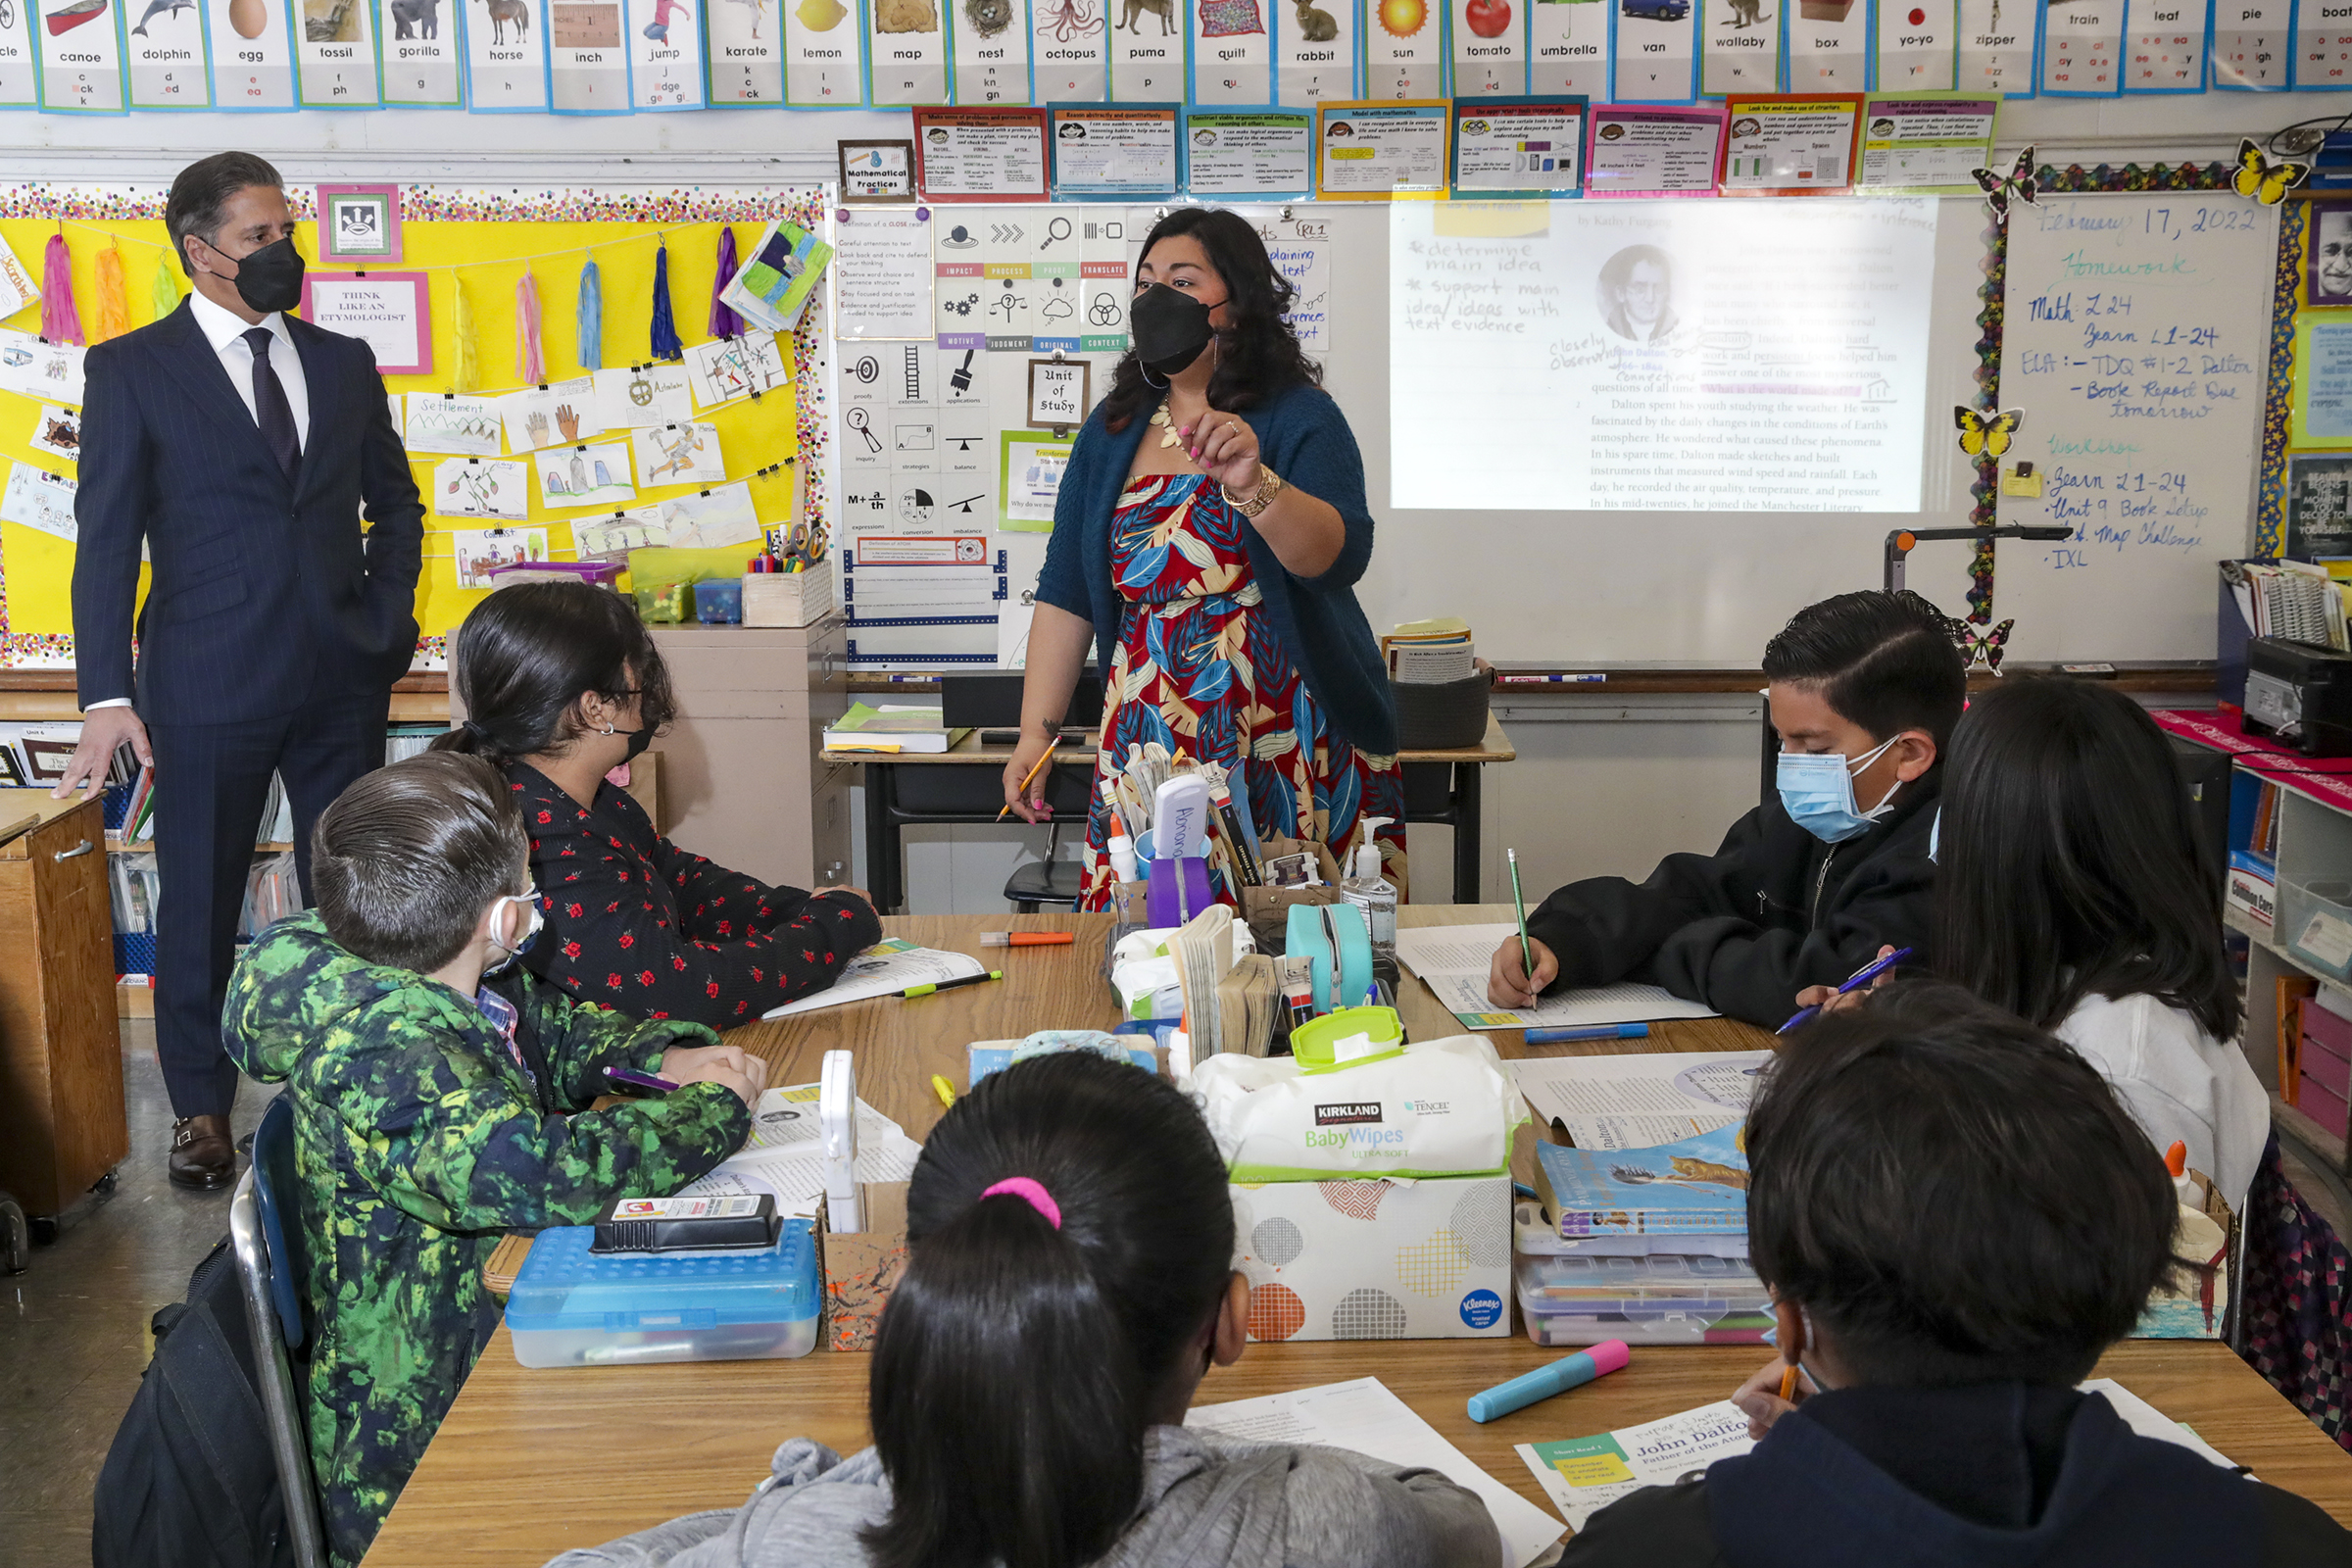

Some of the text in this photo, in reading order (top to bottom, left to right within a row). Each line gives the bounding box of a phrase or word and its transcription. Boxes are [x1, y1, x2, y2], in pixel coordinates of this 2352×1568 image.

[2070, 14, 2099, 24] train
[2154, 10, 2180, 22] leaf
[2242, 9, 2263, 21] pie
[1716, 36, 1766, 49] wallaby
[1815, 37, 1839, 48] box
[1899, 34, 1934, 47] yo-yo
[1976, 33, 2016, 46] zipper
[319, 47, 353, 58] fossil
[399, 46, 440, 60] gorilla
[725, 46, 767, 57] karate
[804, 47, 842, 59] lemon
[978, 48, 1004, 59] nest
[1393, 48, 1414, 58] sun
[1467, 45, 1511, 55] tomato
[1541, 44, 1597, 56] umbrella
[1643, 43, 1666, 52] van
[60, 53, 101, 64] canoe
[142, 49, 191, 61] dolphin
[238, 50, 264, 63] egg
[489, 50, 523, 60] horse
[575, 52, 602, 63] inch
[648, 48, 680, 62] jump
[894, 49, 922, 61] map
[1046, 47, 1097, 61] octopus
[1130, 49, 1165, 60] puma
[1218, 48, 1246, 61] quilt
[1297, 51, 1335, 61] rabbit
[1578, 217, 1591, 227] by
[1593, 216, 1625, 227] Kathy
[2037, 202, 2256, 247] February 17, 2022
[1427, 241, 1533, 258] determine
[1426, 257, 1543, 273] main idea
[2061, 249, 2197, 278] Homework
[1431, 278, 1560, 300] support main
[1518, 300, 1560, 318] with
[2107, 295, 2132, 316] 24
[1405, 317, 1526, 334] text evidence
[2092, 355, 2134, 376] TDQ
[2201, 354, 2253, 375] Dalton
[1045, 369, 1073, 381] Unit
[1053, 384, 1064, 396] of
[2086, 381, 2240, 407] Book Report Due
[420, 398, 483, 414] Settlement
[1040, 400, 1075, 414] Study
[1611, 399, 1645, 410] Dalton
[1648, 401, 1676, 412] spent
[1679, 400, 1694, 410] his
[1697, 400, 1727, 412] youth
[1730, 402, 1774, 414] studying
[1777, 402, 1793, 411] the
[1843, 404, 1858, 413] He
[2110, 399, 2215, 419] tomorrow
[1656, 433, 1670, 443] He
[1673, 433, 1723, 443] wondered
[1591, 466, 1650, 476] instruments
[2050, 496, 2093, 519] Unit
[2121, 496, 2158, 517] Book
[2094, 521, 2202, 555] Map Challenge
[2052, 550, 2088, 569] IXL
[1318, 1105, 1380, 1118] KIRKLAND
[1414, 1102, 1448, 1111] TENCEL
[1351, 1150, 1408, 1159] ULTRA SOFT
[1463, 1298, 1500, 1310] Kleenex
[1636, 1420, 1748, 1457] John Dalto
[1553, 1446, 1595, 1457] Short Read
[1642, 1452, 1682, 1465] Father
[1697, 1441, 1719, 1452] the
